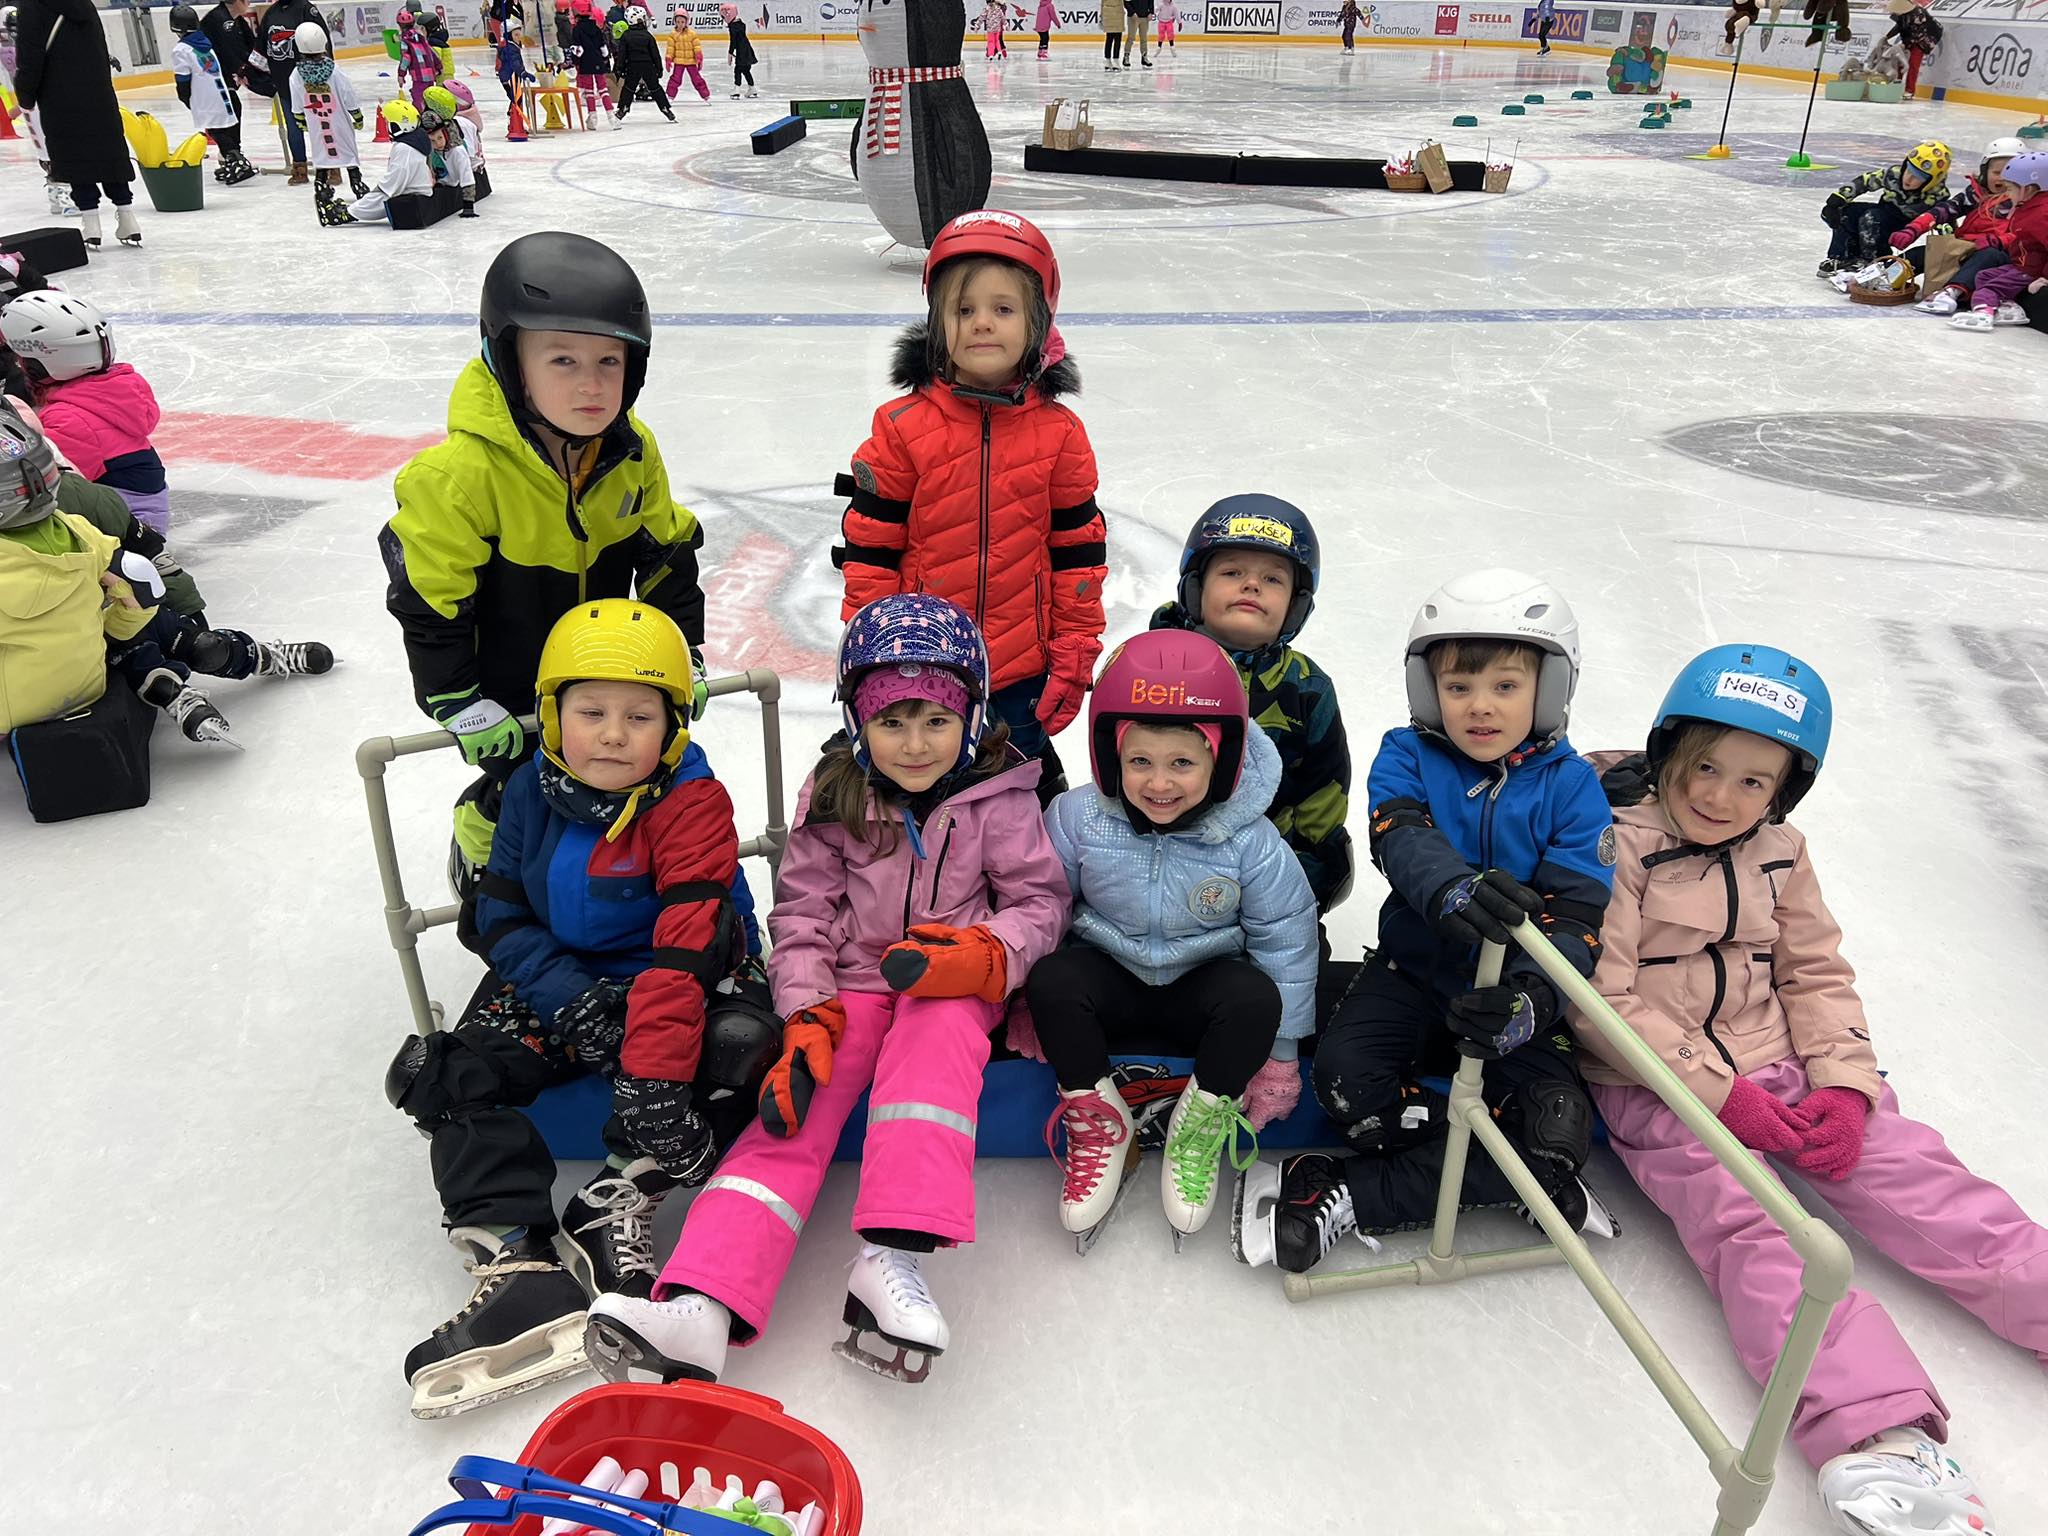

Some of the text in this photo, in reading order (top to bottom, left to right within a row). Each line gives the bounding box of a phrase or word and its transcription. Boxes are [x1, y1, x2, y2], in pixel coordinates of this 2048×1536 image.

[697, 3, 723, 12] WRA
[1438, 7, 1458, 17] KJG
[695, 17, 724, 26] WASH
[776, 13, 802, 24] lama
[1180, 10, 1203, 24] kraj
[1468, 14, 1512, 24] STELLA
[1373, 23, 1421, 36] Chomutov
[1966, 40, 2033, 85] arena
[1131, 678, 1185, 706] Beri
[1724, 676, 1800, 714] Nelča S.
